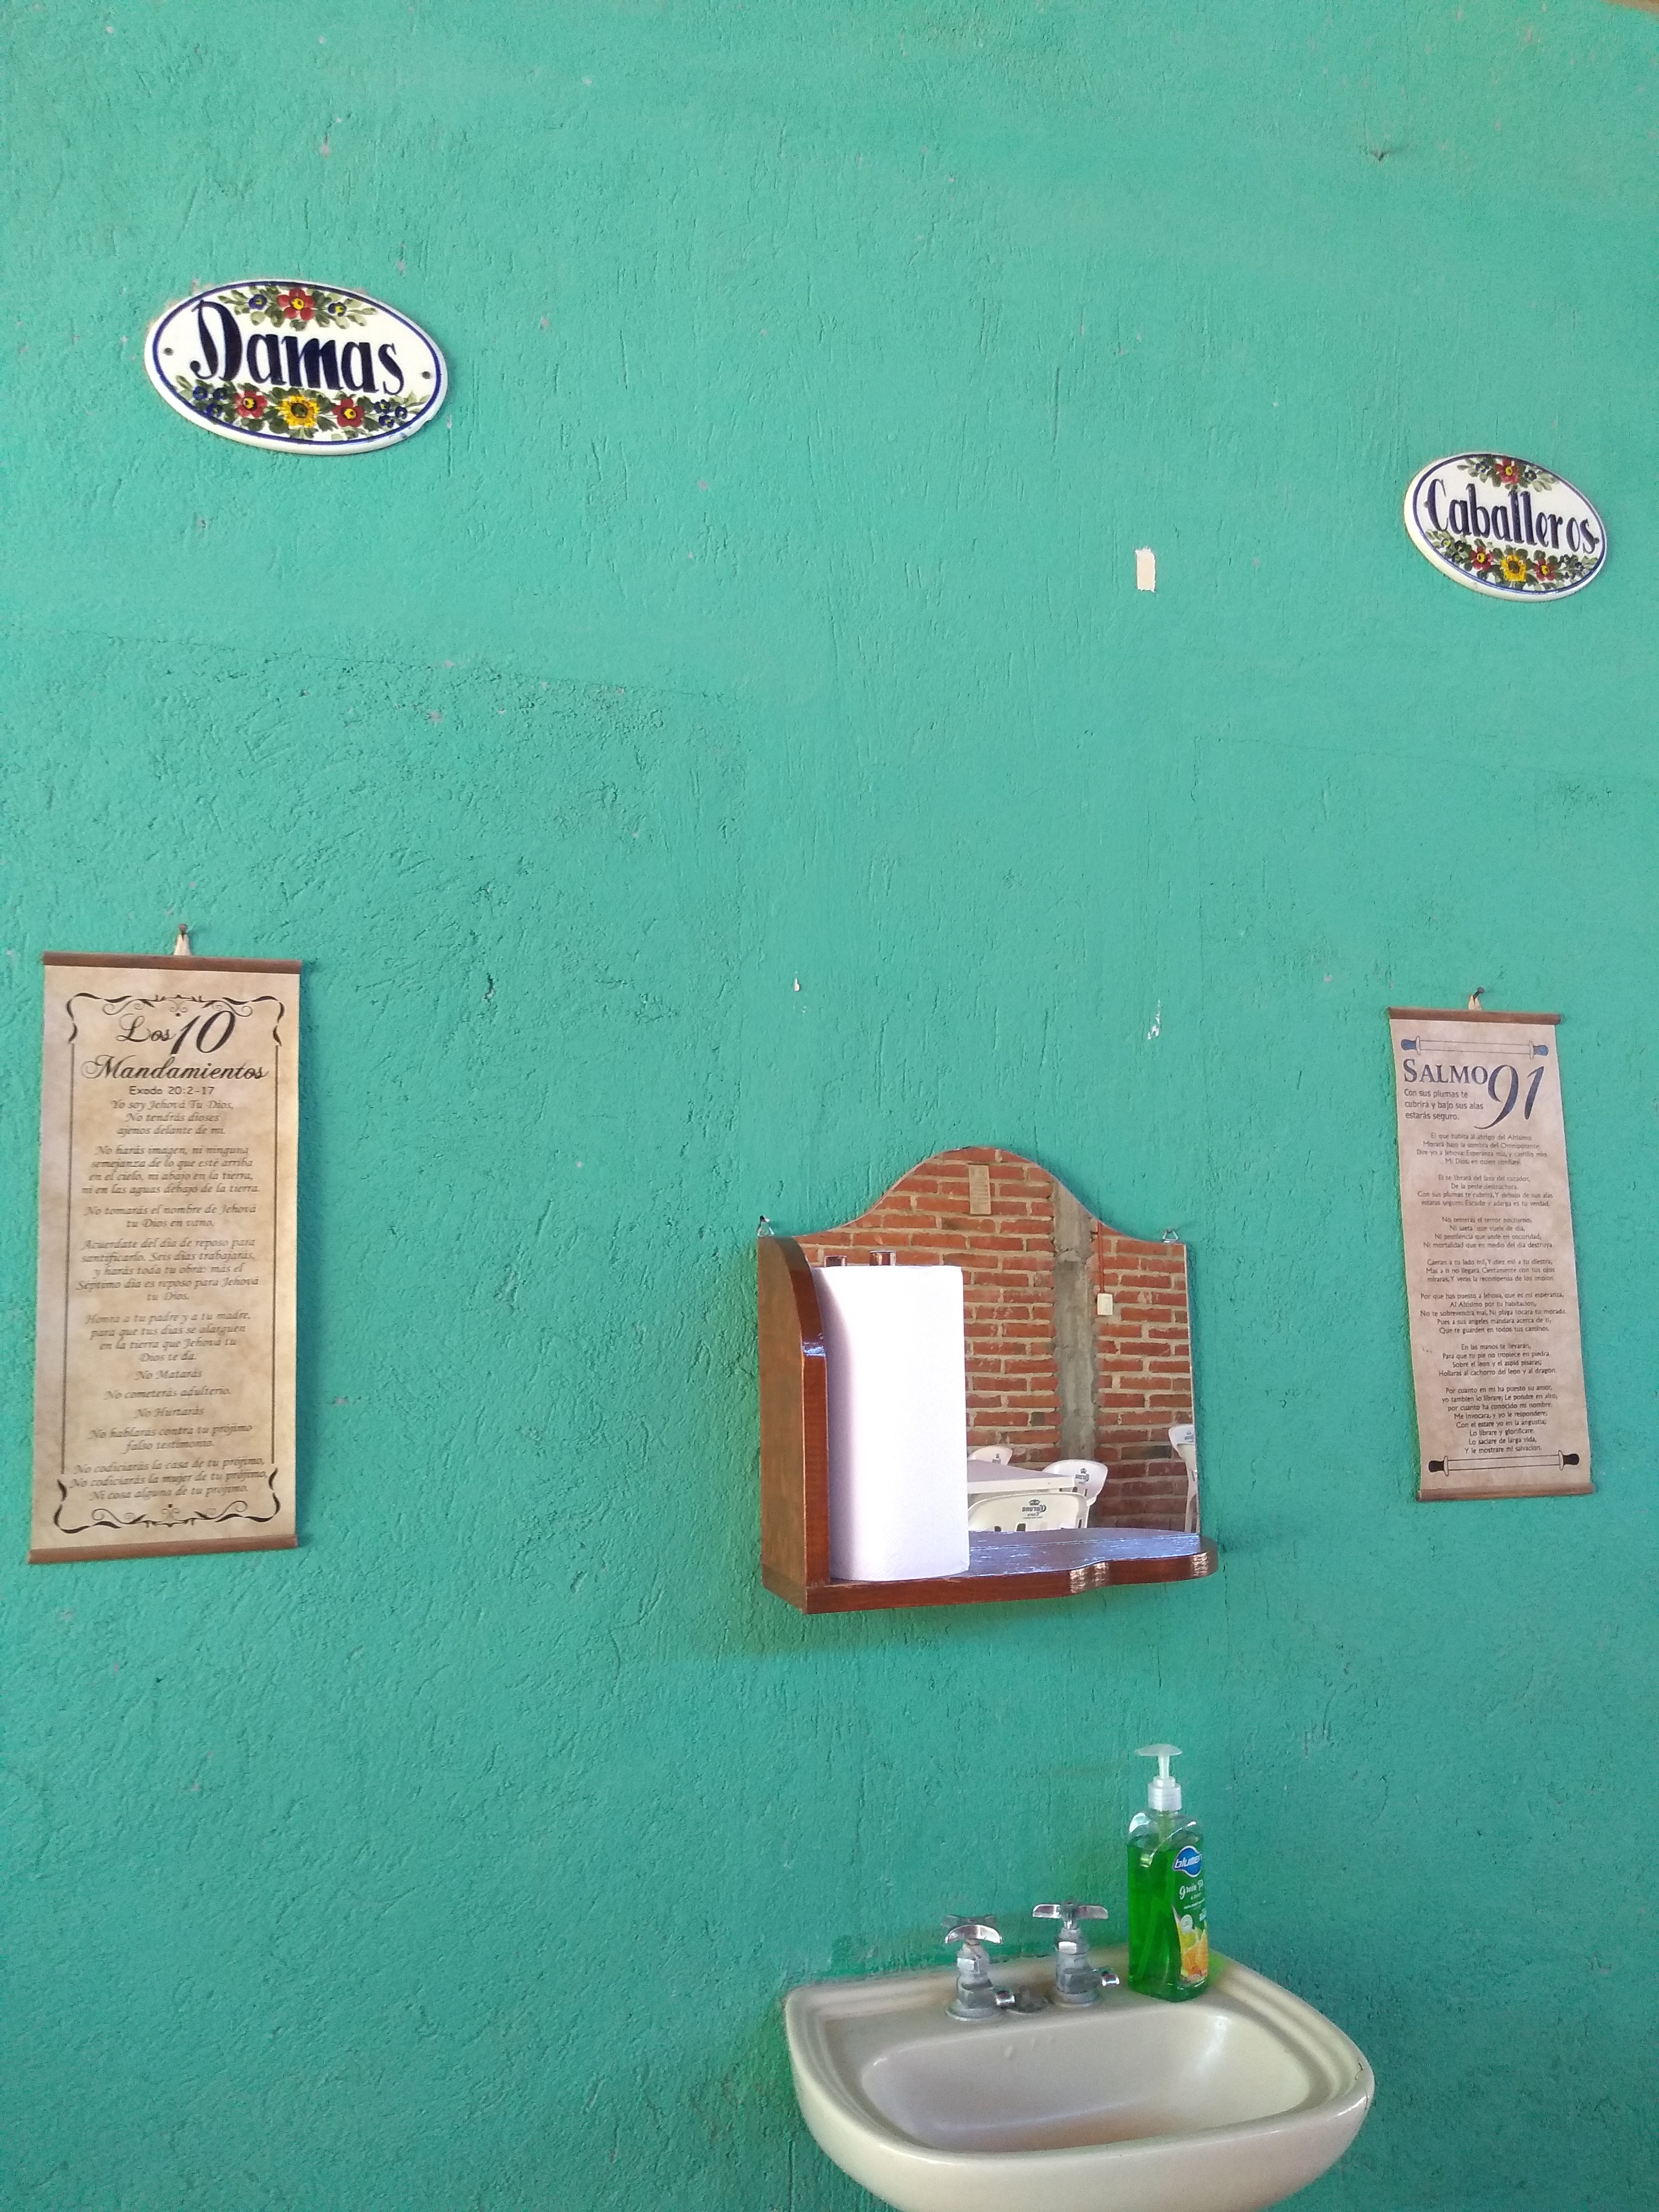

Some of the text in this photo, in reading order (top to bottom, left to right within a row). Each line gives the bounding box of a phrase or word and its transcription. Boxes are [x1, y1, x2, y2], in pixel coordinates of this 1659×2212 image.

[190, 300, 405, 395] Damas
[1426, 479, 1596, 554] Caballeros
[116, 1010, 236, 1055] Los 10
[81, 1054, 269, 1079] Mandamientos
[129, 1086, 215, 1095] Exodo 20:2-17
[1403, 1059, 1544, 1129] SALMO 91
[1433, 1090, 1459, 1100] plumas
[1405, 1100, 1429, 1108] cubrirá
[1431, 1102, 1435, 1110] y
[1437, 1101, 1453, 1111] bajo
[1432, 1113, 1460, 1122] seguro.
